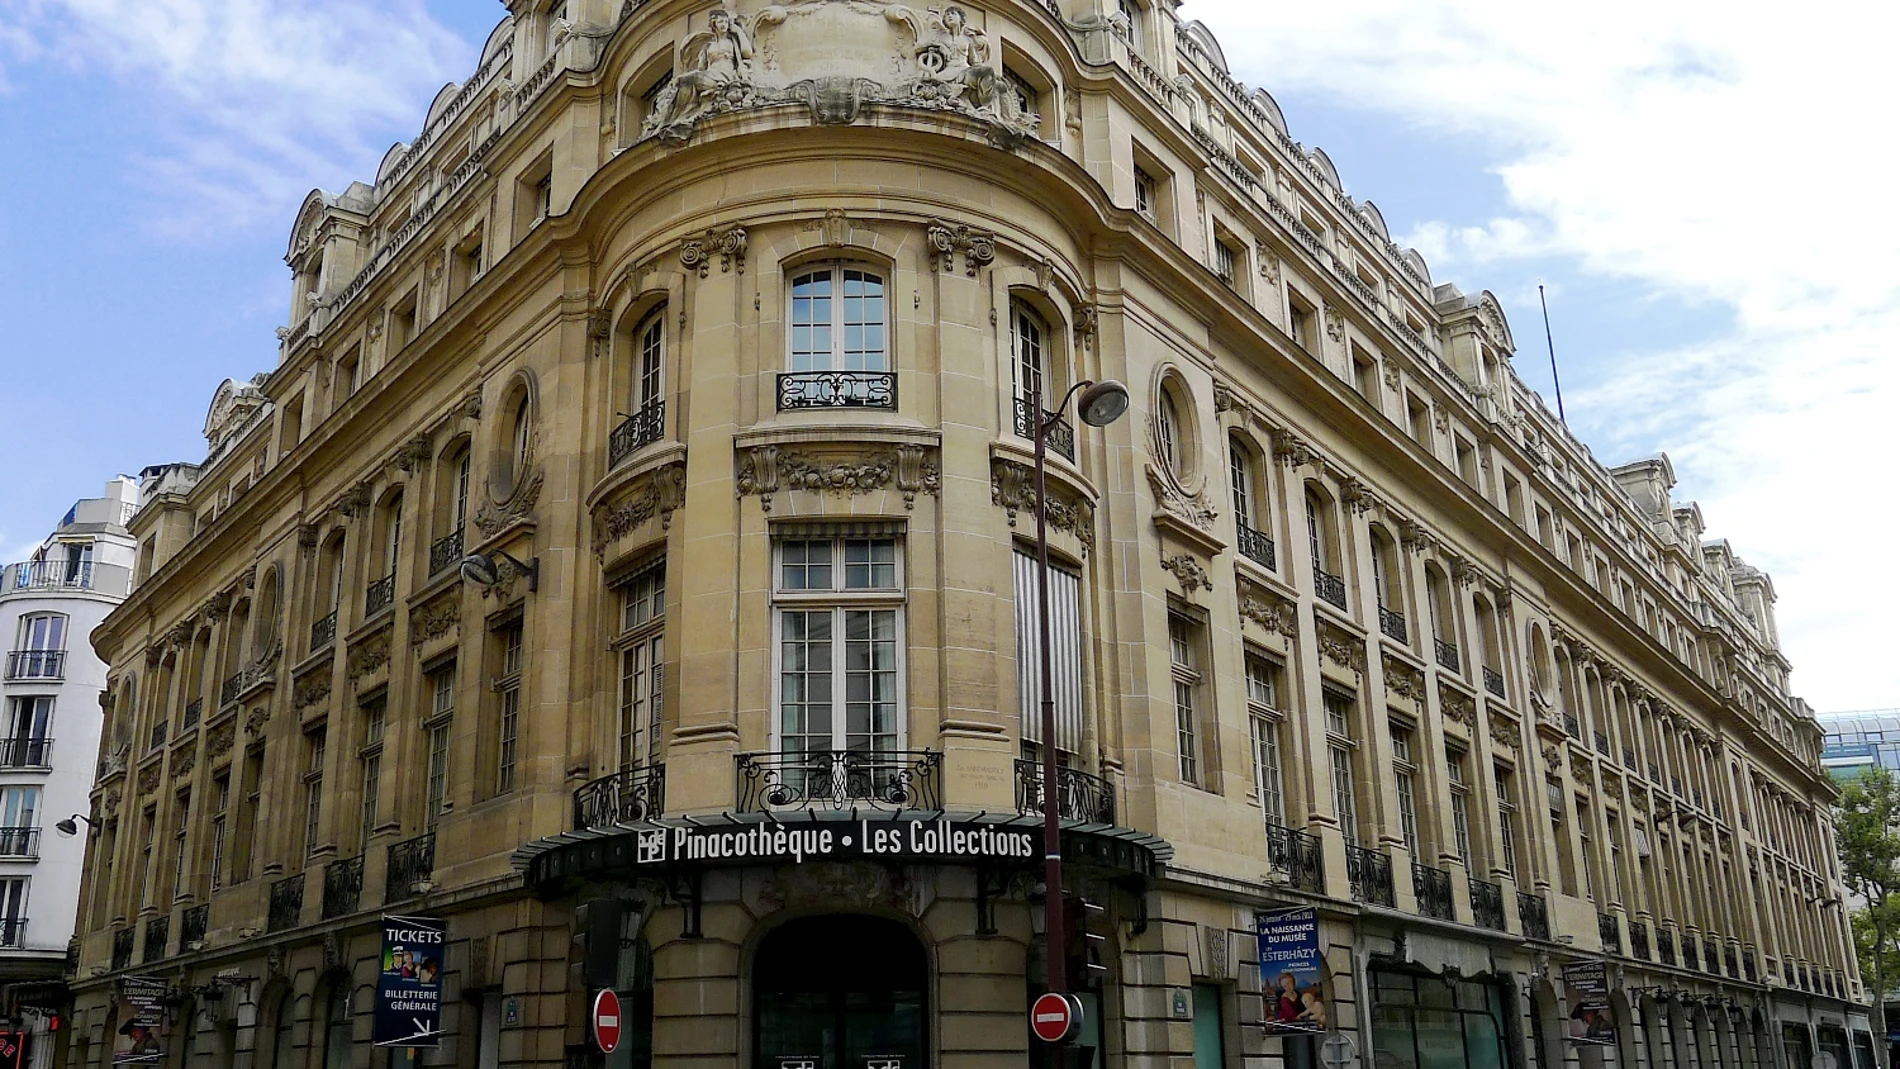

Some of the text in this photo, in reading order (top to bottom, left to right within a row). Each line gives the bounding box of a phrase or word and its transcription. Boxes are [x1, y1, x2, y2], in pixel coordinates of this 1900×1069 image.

[673, 819, 1032, 864] Pinacothèque Les Collections
[1271, 923, 1314, 934] NAISSANCE
[386, 928, 441, 944] TICKETS
[1269, 932, 1307, 943] DU MUSÉE
[1262, 946, 1316, 962] ESTERHÁZY
[384, 989, 438, 1000] BILLETTERIE
[390, 1000, 437, 1011] GÉNÉRALE
